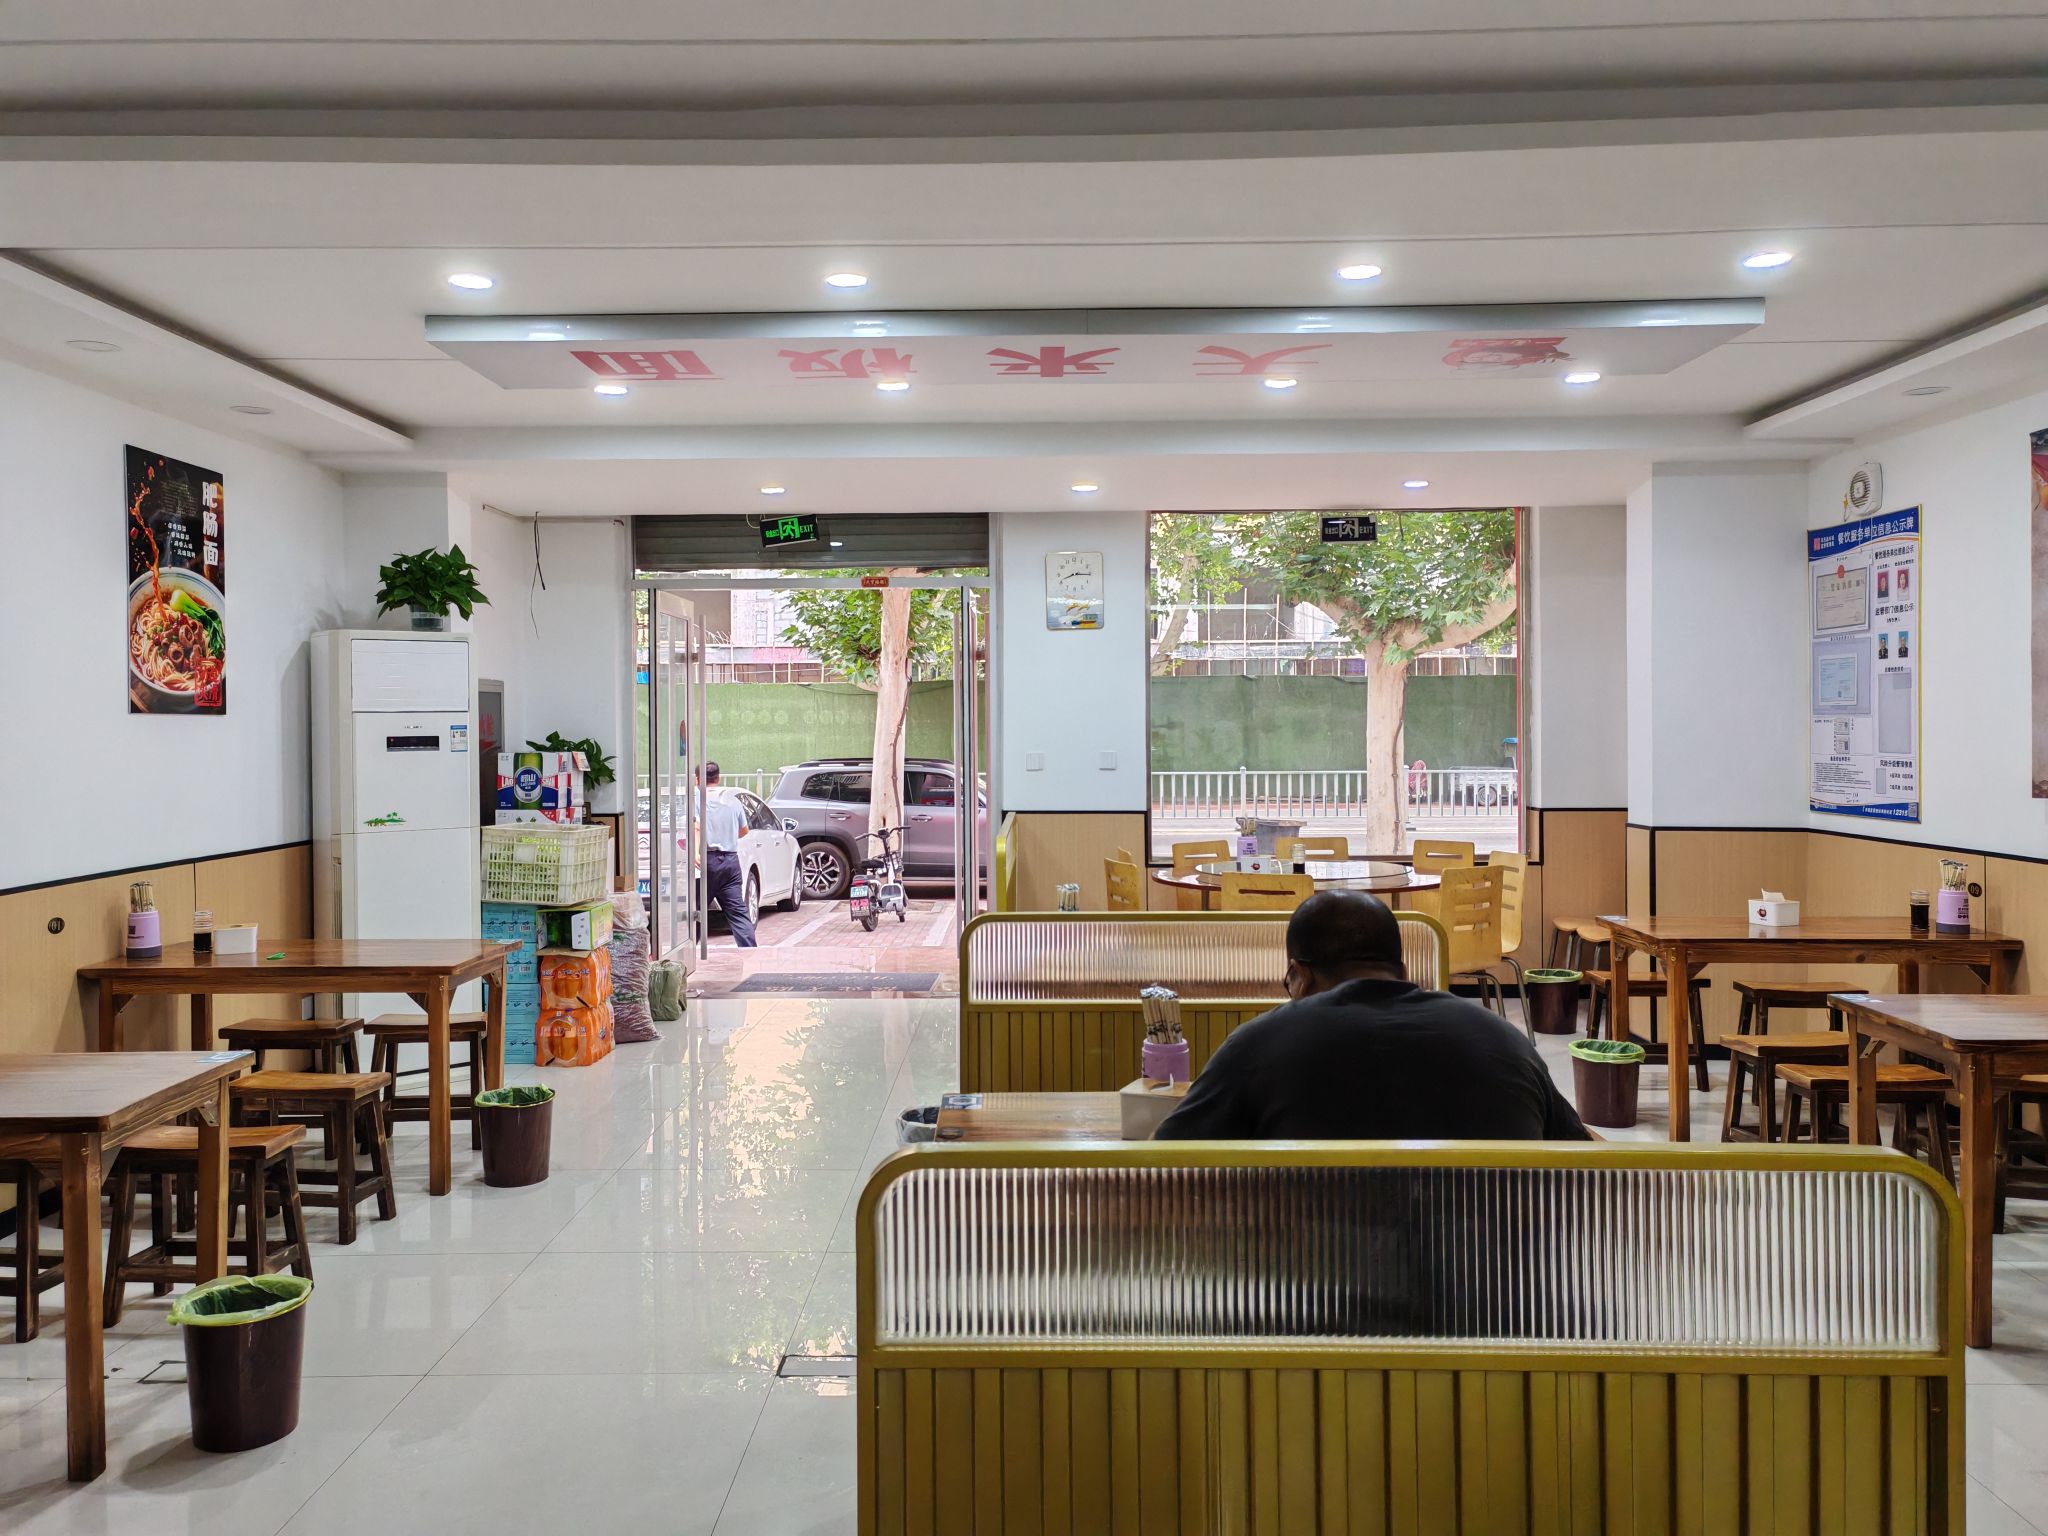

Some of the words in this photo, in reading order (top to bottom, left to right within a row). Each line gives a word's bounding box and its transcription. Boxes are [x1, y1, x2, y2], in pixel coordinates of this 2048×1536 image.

[202, 481, 219, 566] 肥肠面
[799, 524, 814, 533] EXIT
[1359, 526, 1374, 534] EXIT
[1837, 516, 1914, 546] 餐饮服务单位信息公示牌
